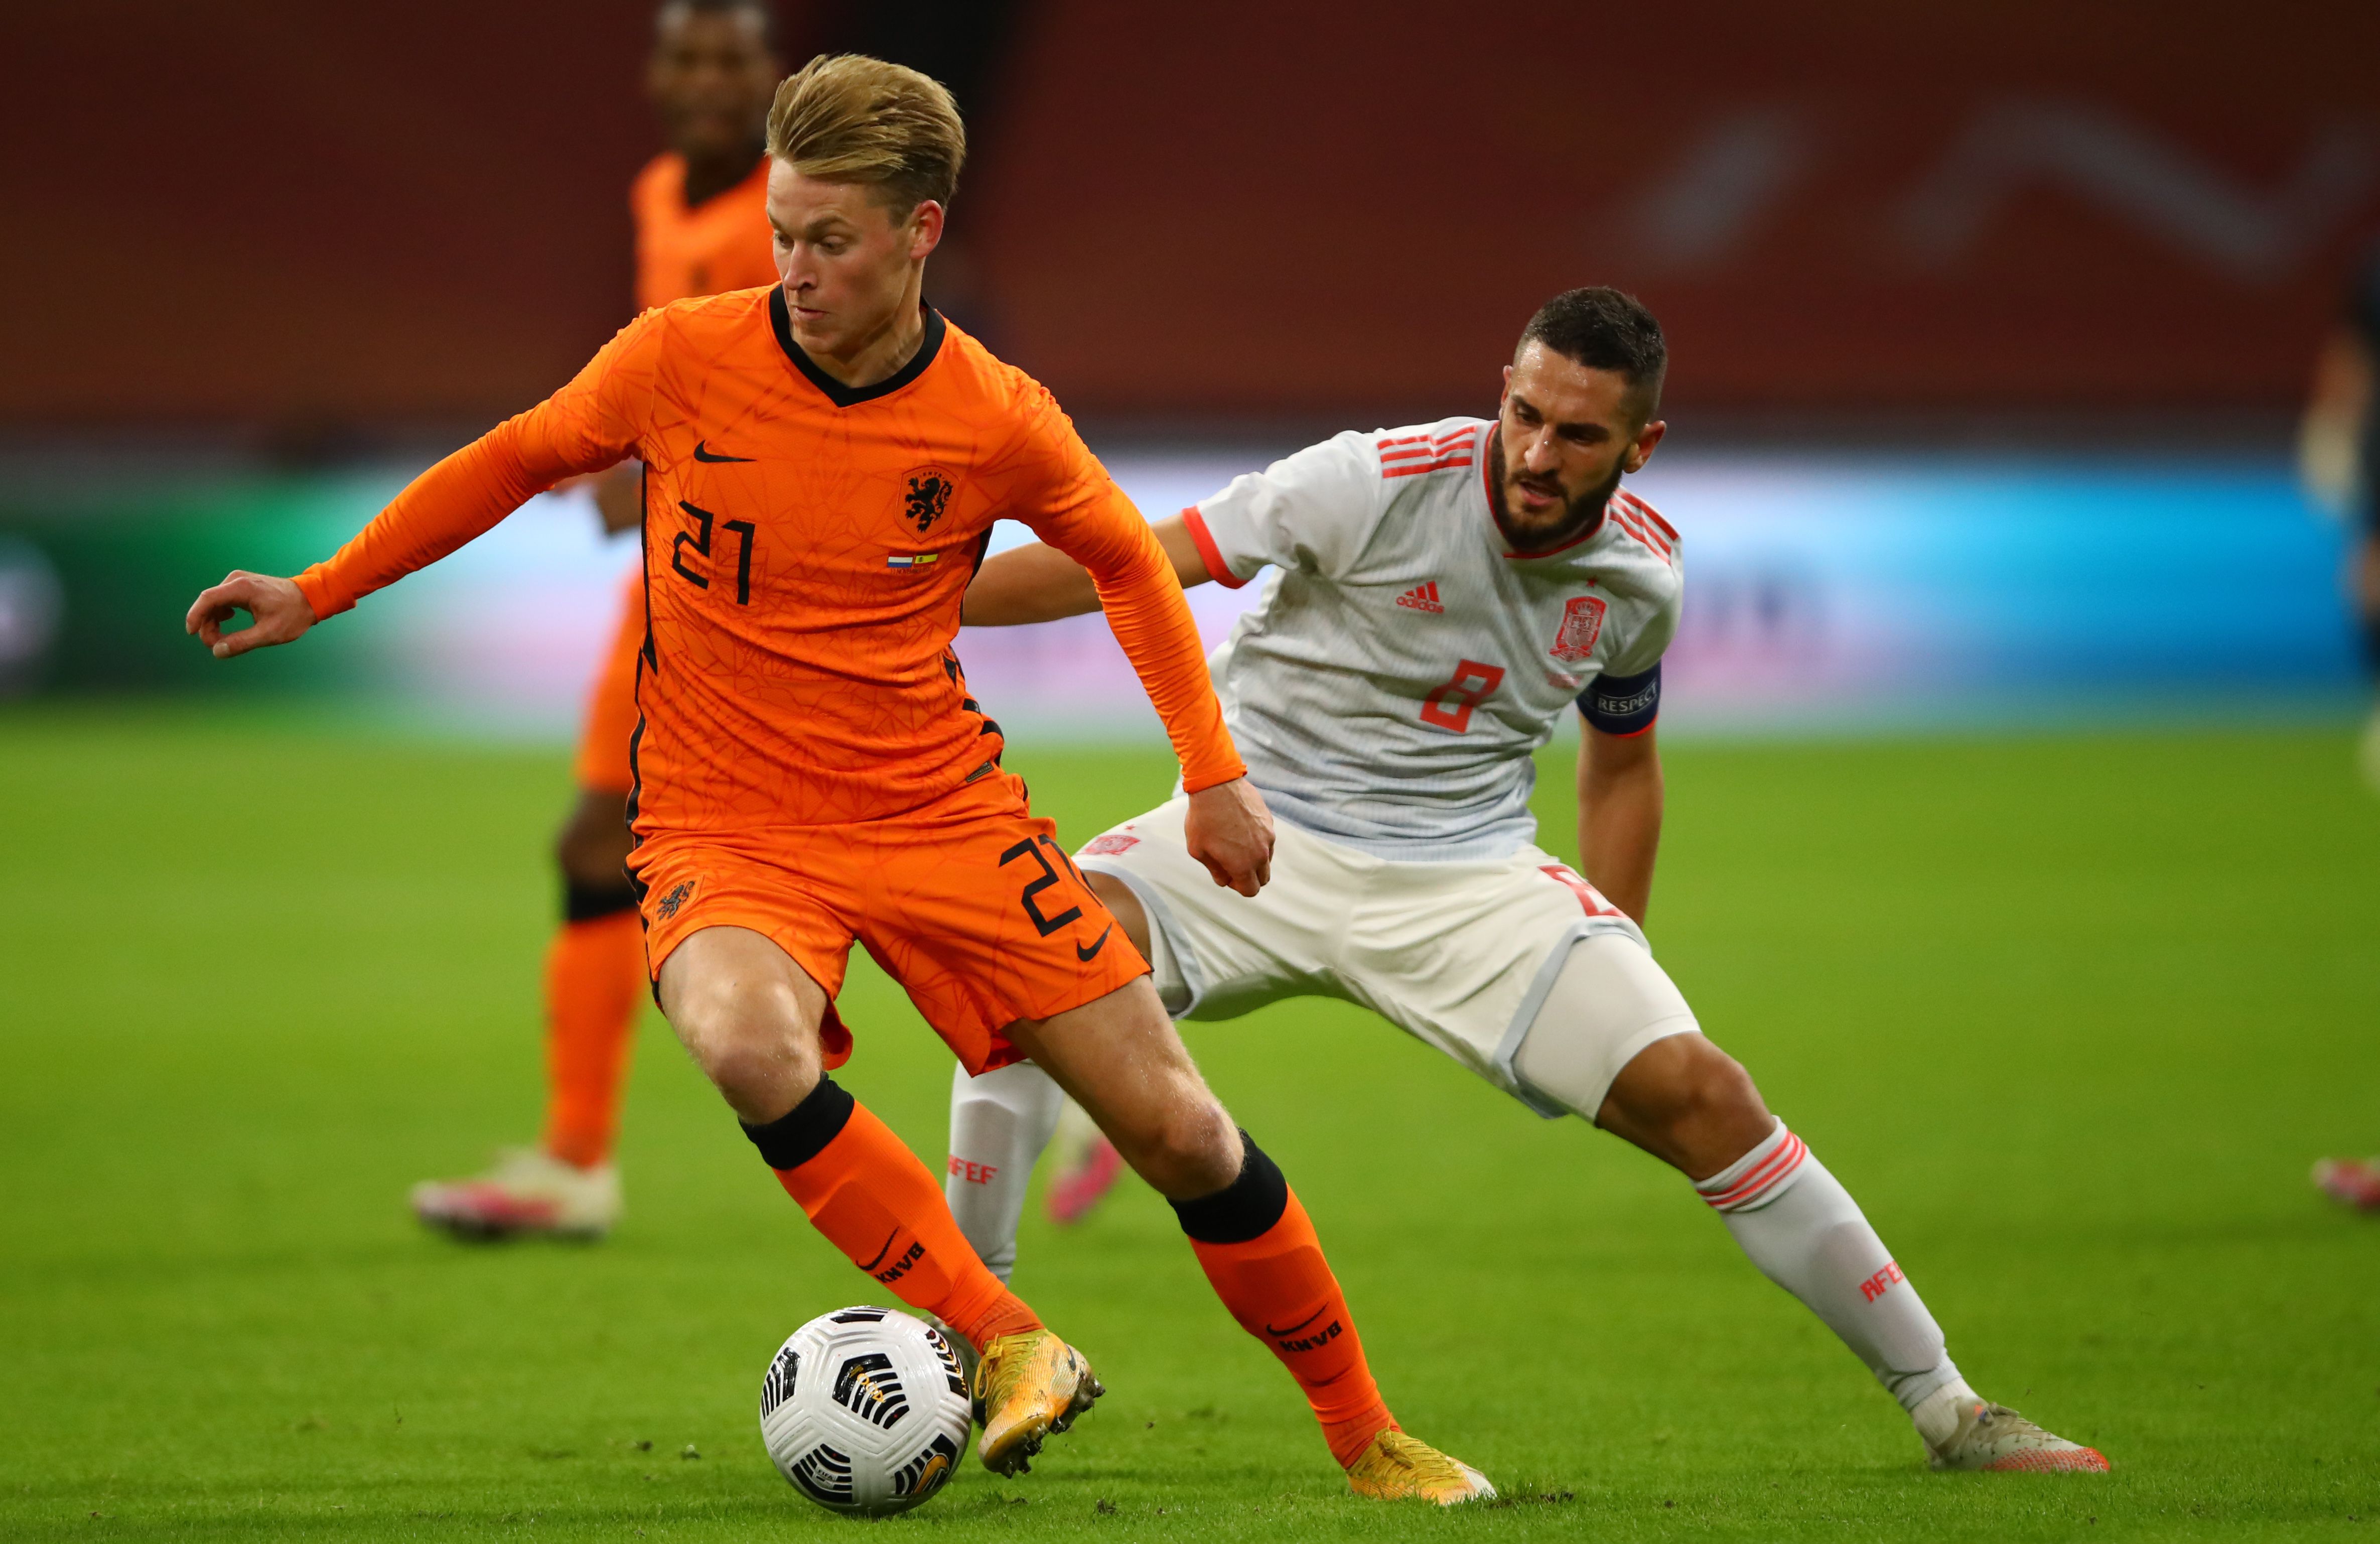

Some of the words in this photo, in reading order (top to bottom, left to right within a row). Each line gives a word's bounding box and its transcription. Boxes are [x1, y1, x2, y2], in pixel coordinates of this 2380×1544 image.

[672, 500, 755, 606] 21
[1396, 596, 1445, 614] adidas
[1420, 659, 1504, 734] 8
[1598, 682, 1656, 712] RESPECT
[1536, 864, 1631, 918] 8
[875, 1241, 926, 1283] KNVB
[1279, 1319, 1343, 1351] KNVB
